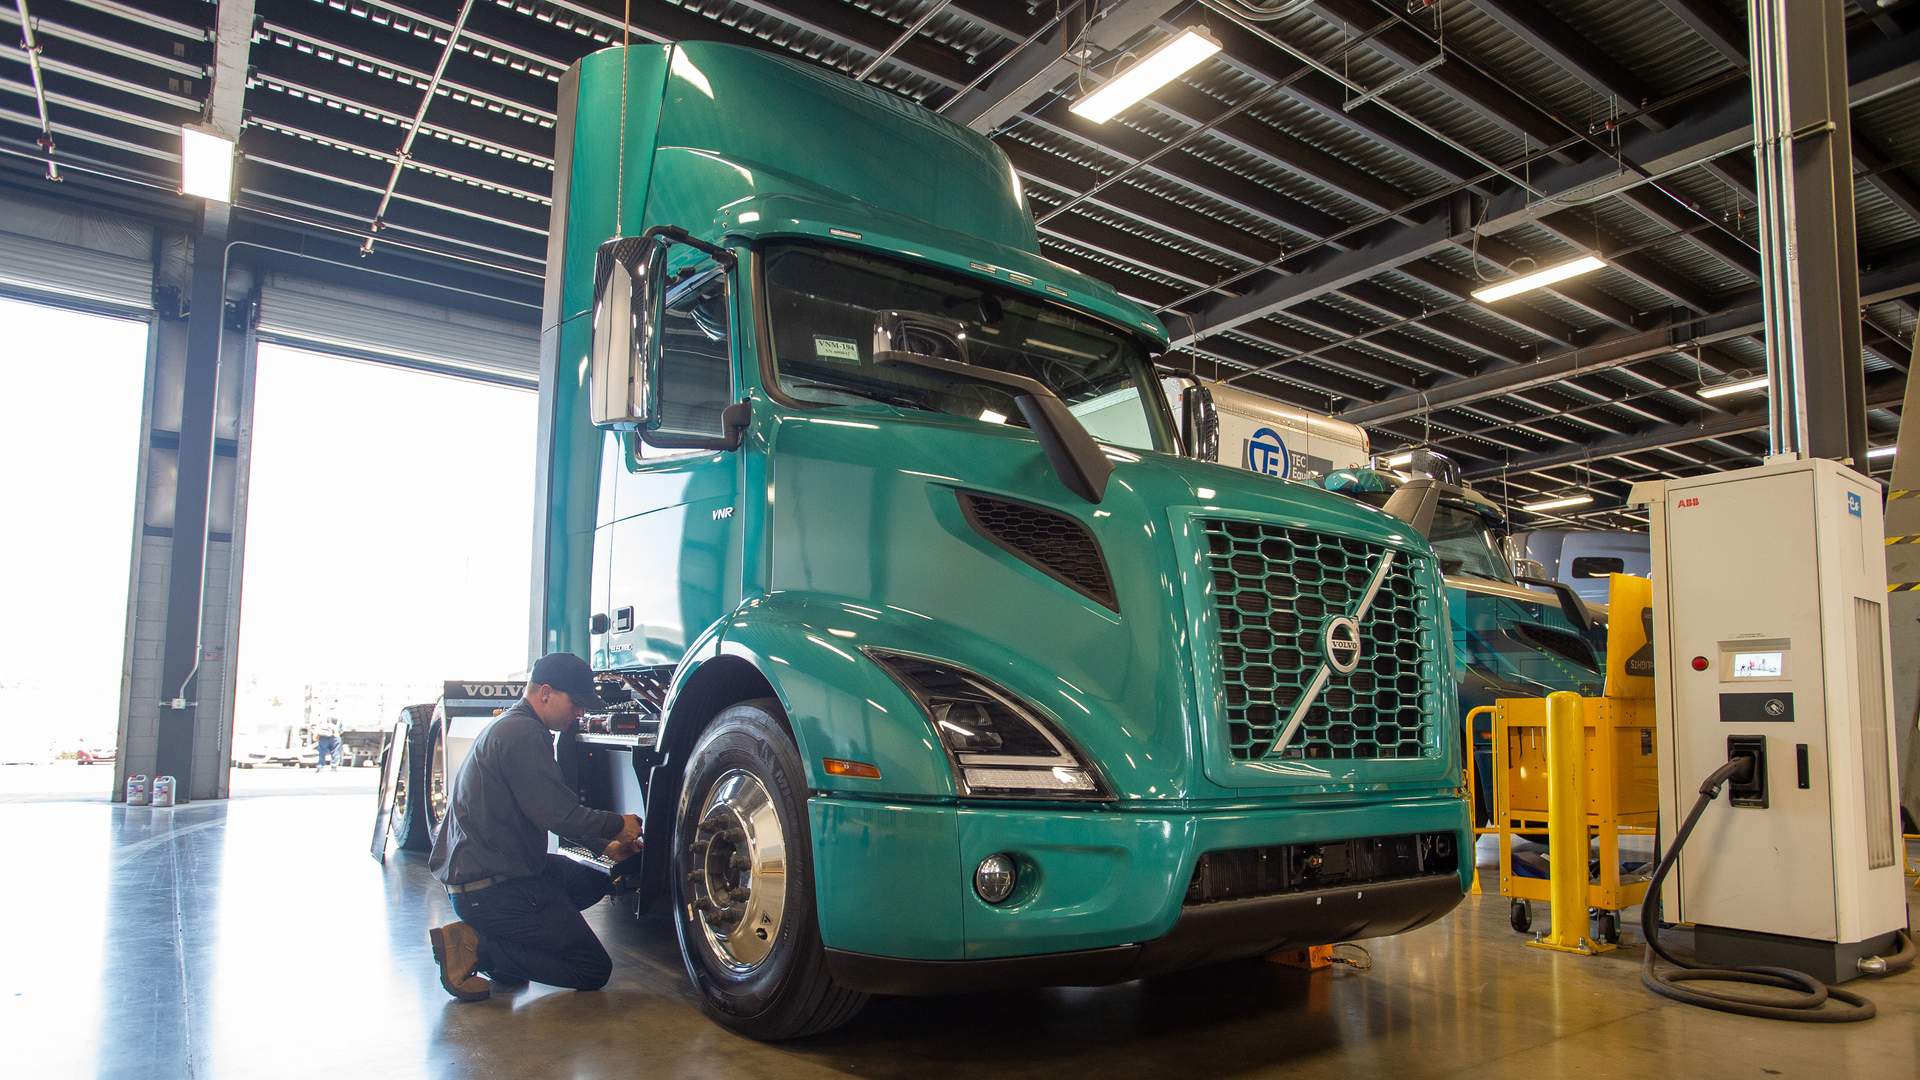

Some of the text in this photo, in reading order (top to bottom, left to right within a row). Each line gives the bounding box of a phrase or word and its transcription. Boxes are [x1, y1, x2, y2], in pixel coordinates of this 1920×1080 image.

[818, 340, 855, 351] VNM-194
[1291, 453, 1306, 468] TEC
[1677, 497, 1700, 509] ABB
[712, 506, 734, 521] VNR
[1332, 641, 1358, 649] VOLVO
